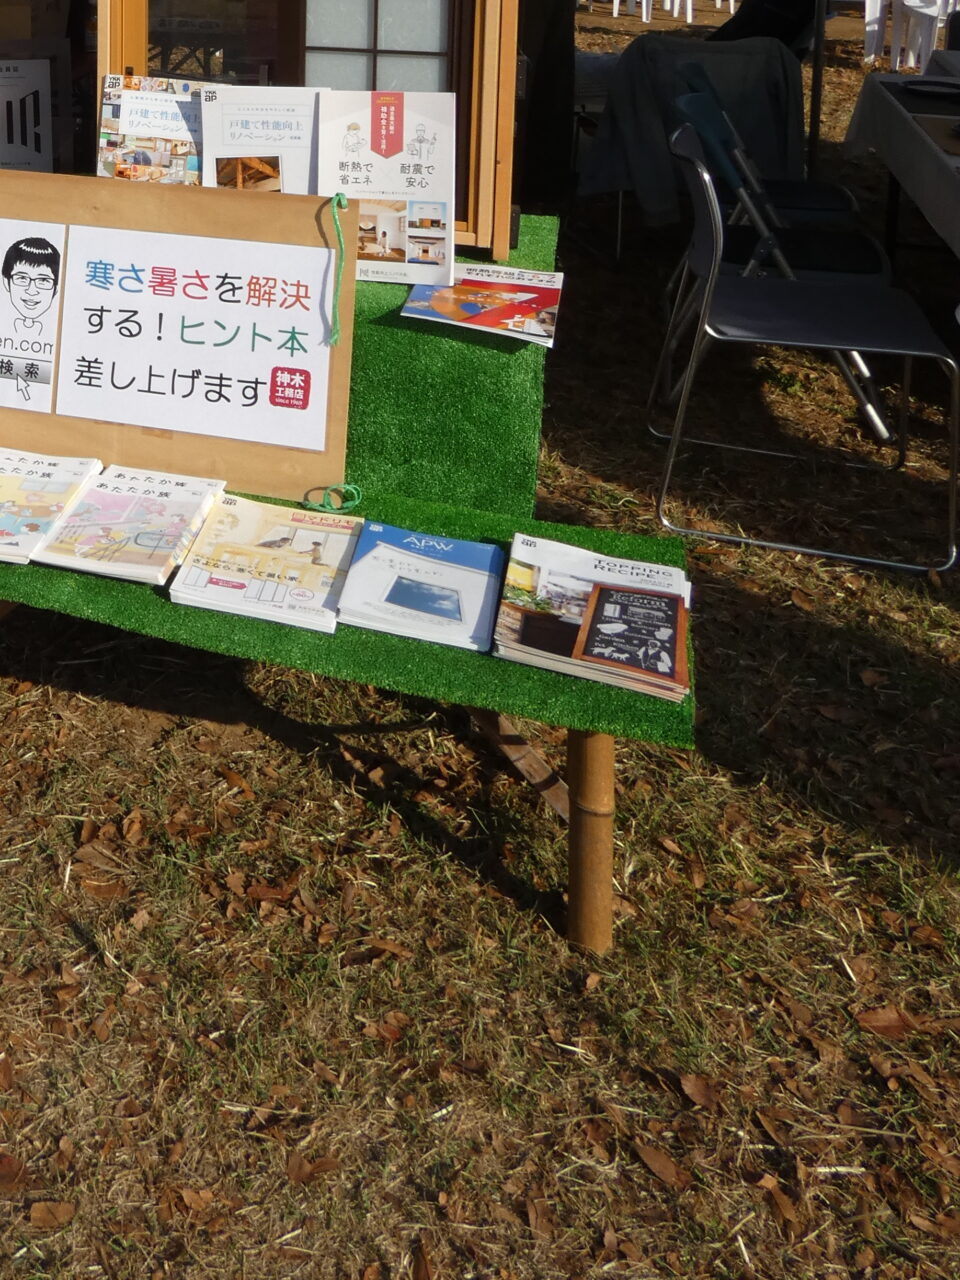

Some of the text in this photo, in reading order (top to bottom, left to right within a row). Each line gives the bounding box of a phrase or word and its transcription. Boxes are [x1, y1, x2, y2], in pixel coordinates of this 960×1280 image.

[229, 120, 304, 132] 戸建て性能向上
[339, 161, 374, 173] 断熱で
[400, 163, 435, 175] 耐震で
[339, 174, 373, 186] 省エネ
[406, 176, 429, 188] 安心
[84, 259, 311, 312] 寒さ暑さを解決
[74, 355, 267, 408] 差し上げます
[276, 370, 305, 388] 神木
[275, 387, 304, 400] 工務店
[96, 482, 172, 498] あたたか族
[402, 536, 453, 551] APW
[594, 564, 656, 579] RECIPE
[595, 558, 673, 577] TOPPING
